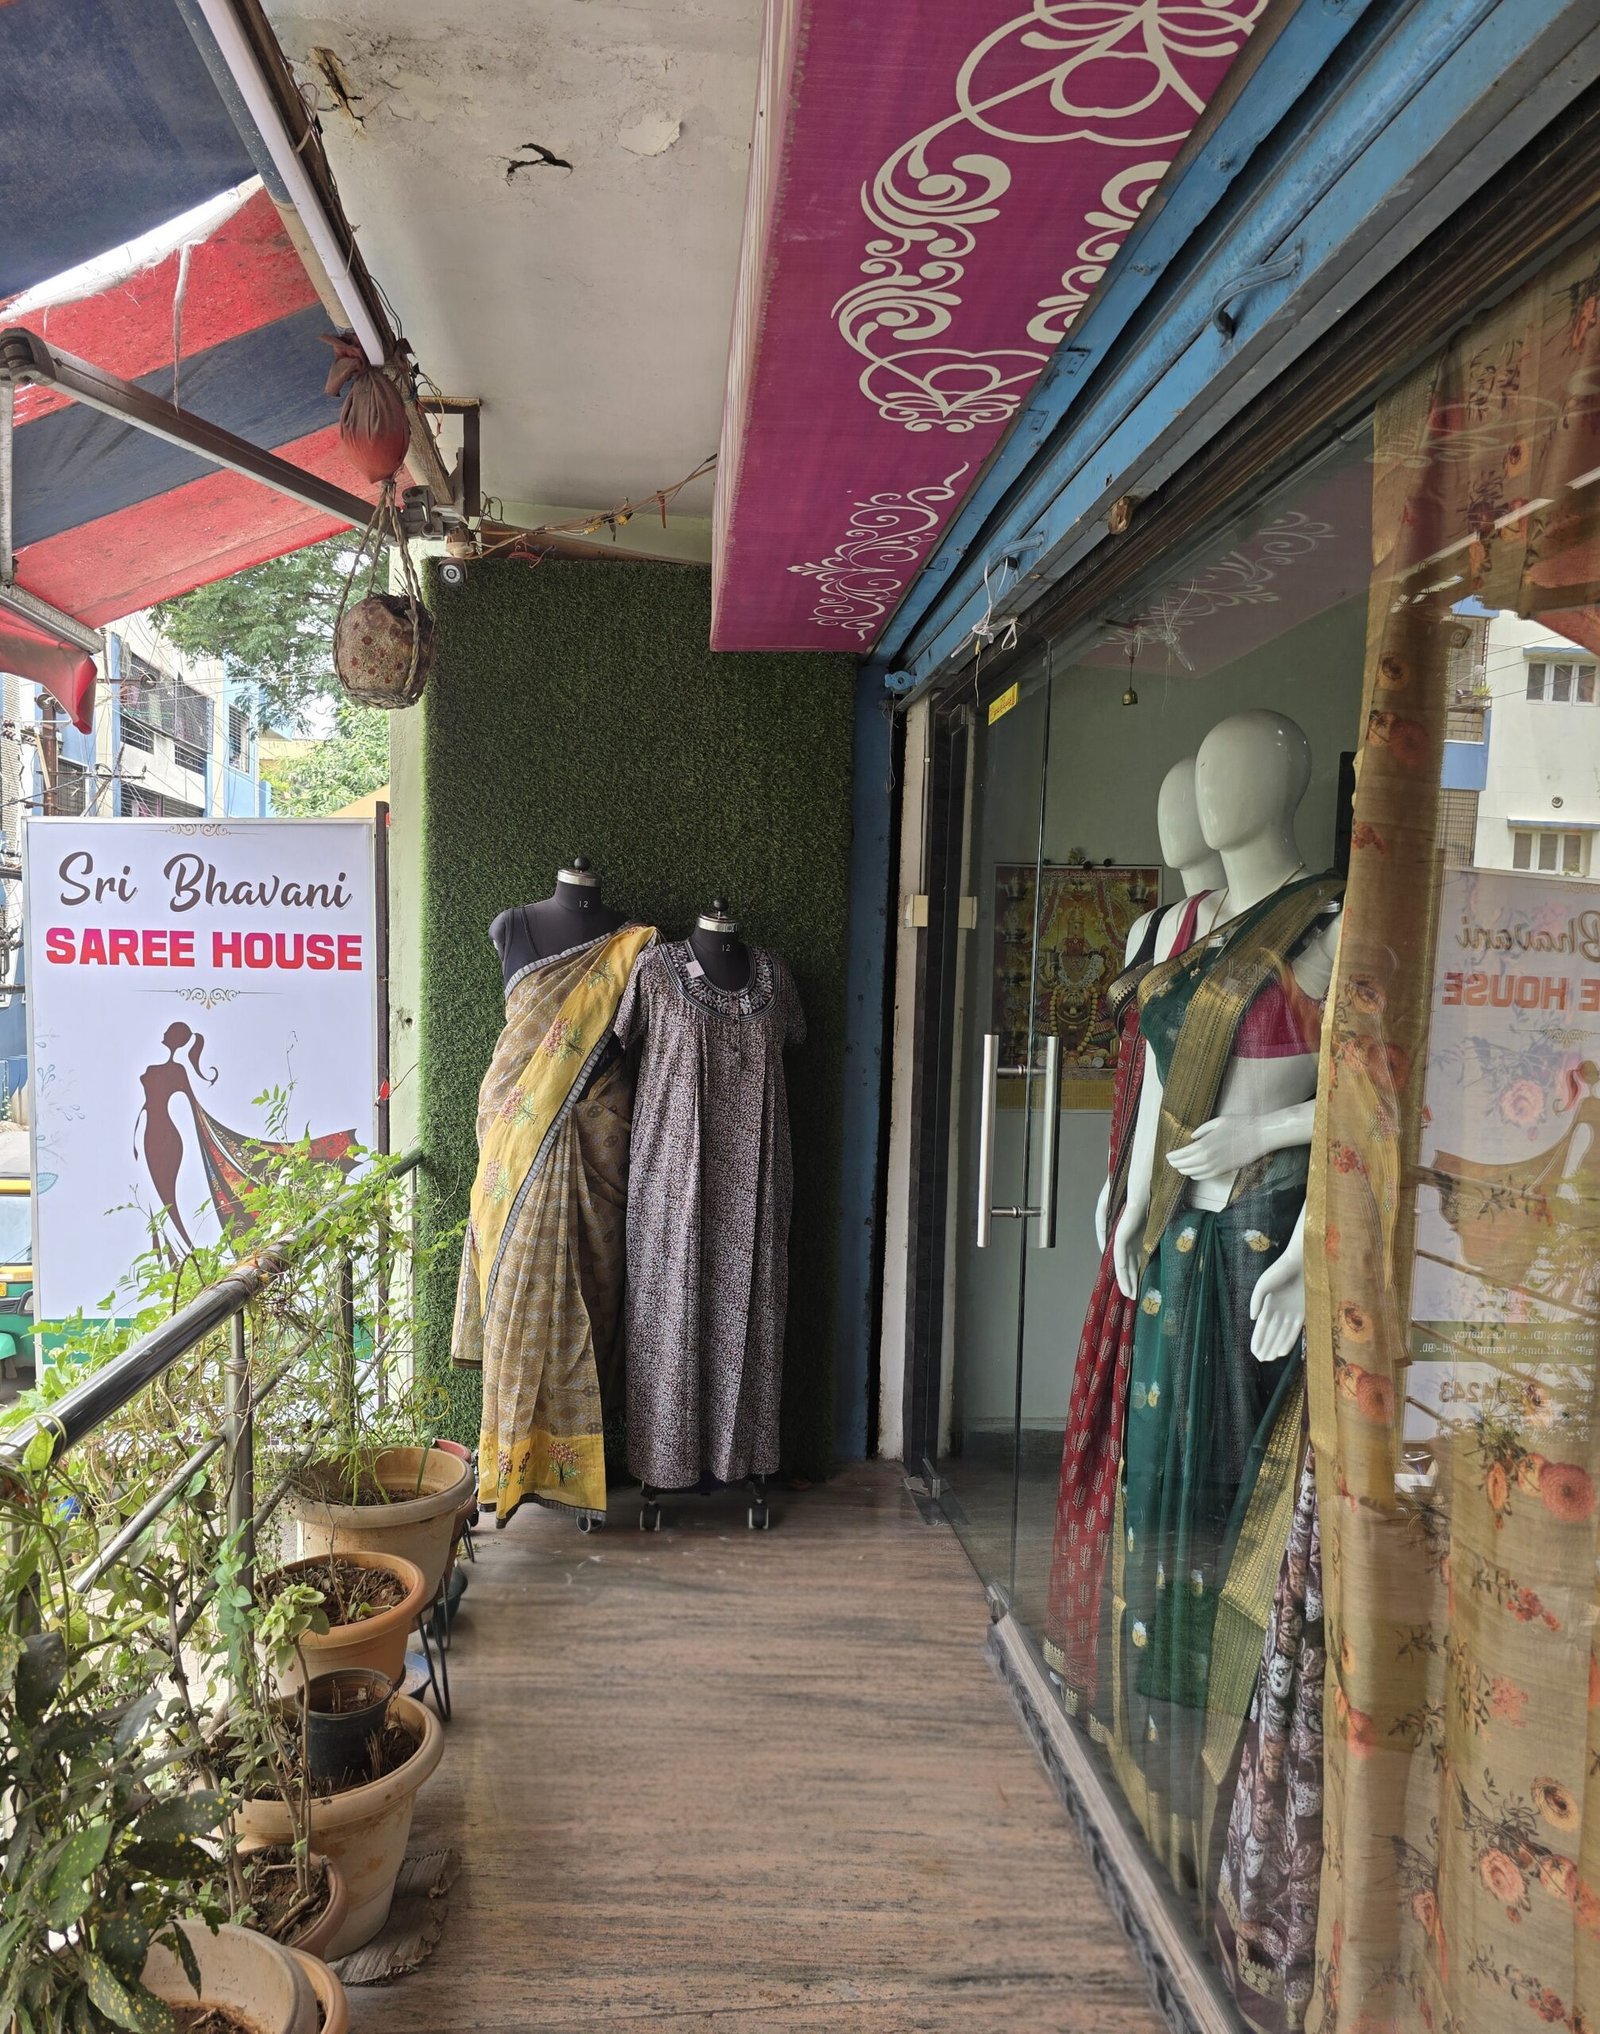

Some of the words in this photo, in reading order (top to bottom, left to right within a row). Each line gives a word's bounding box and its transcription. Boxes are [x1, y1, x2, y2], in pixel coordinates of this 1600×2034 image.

[59, 851, 138, 906] Sri
[163, 853, 353, 912] Bhavani
[578, 900, 589, 908] 12
[46, 927, 196, 968] SAREE
[212, 931, 363, 971] HOUSE
